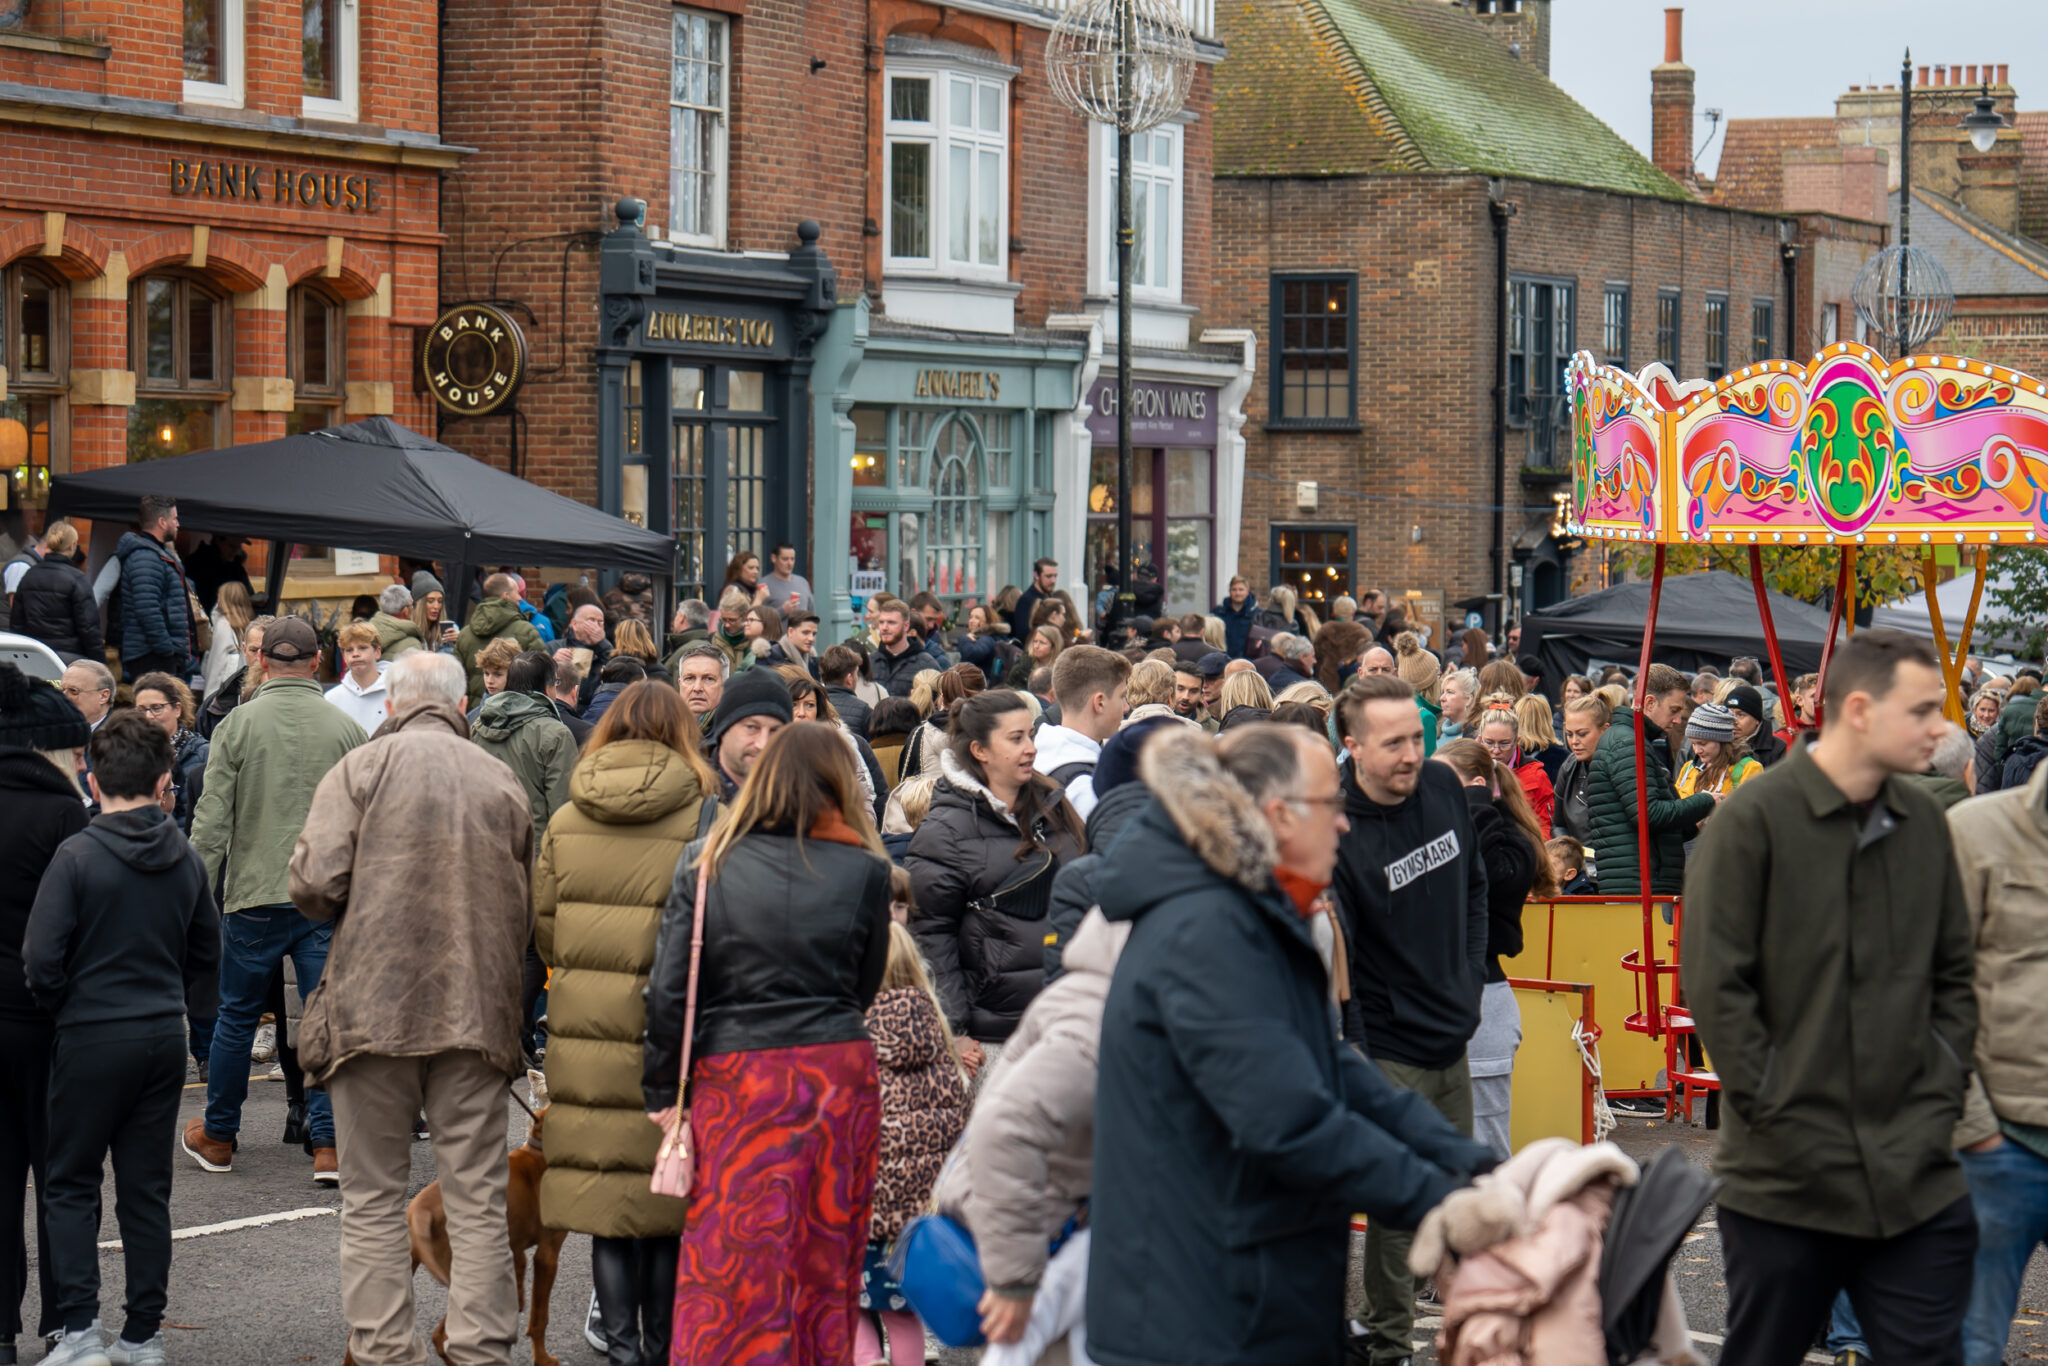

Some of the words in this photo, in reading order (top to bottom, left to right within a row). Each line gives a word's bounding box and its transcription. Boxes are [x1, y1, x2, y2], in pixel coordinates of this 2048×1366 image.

[170, 158, 263, 201] BANK
[274, 168, 382, 213] HOUSE
[440, 315, 504, 343] BANK
[647, 310, 737, 344] ANNABEL'S
[739, 317, 774, 347] TOO
[434, 371, 508, 406] HOUSE
[914, 369, 1001, 401] ANNABEL'S
[1100, 386, 1165, 418] CHMPION
[1169, 390, 1207, 419] WINES
[1391, 836, 1457, 886] GYMSHARK
